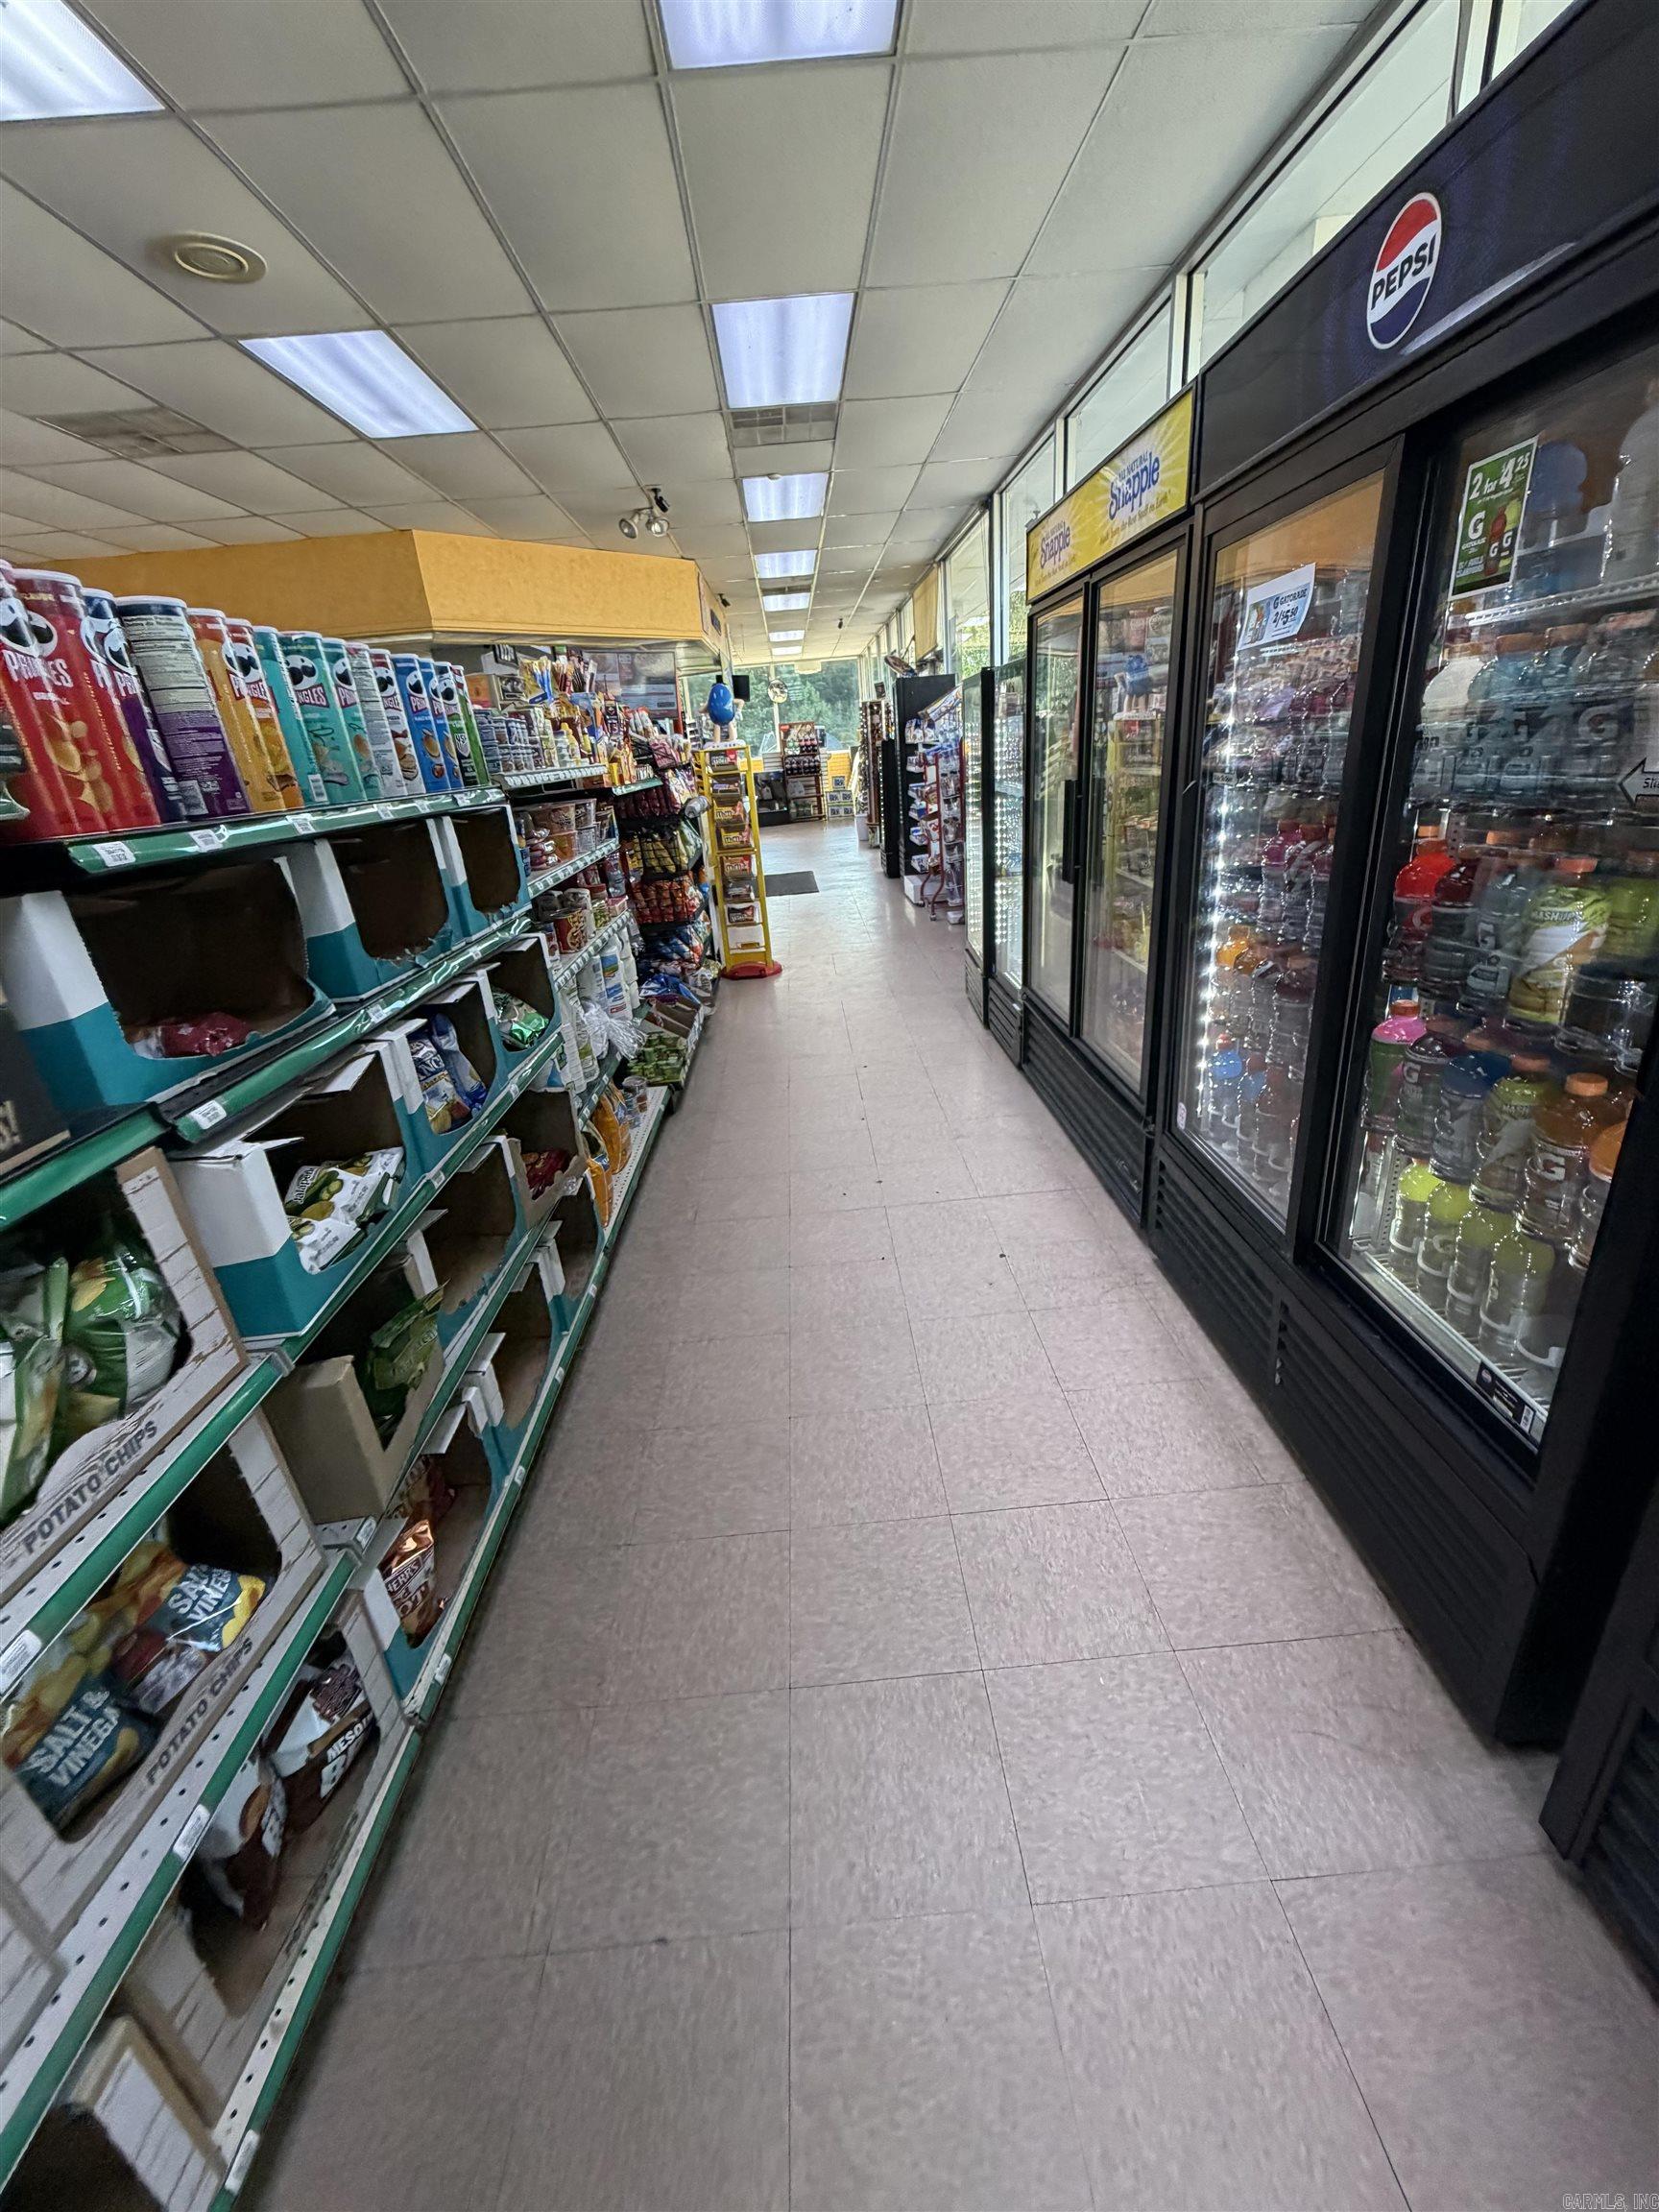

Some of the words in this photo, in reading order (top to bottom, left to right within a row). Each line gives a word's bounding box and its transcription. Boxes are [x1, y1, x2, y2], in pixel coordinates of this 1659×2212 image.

[1370, 232, 1437, 311] PEPSI
[1109, 451, 1160, 521] Snapple
[1469, 471, 1483, 500] 2
[1040, 520, 1070, 569] Snapple
[1468, 510, 1486, 540] G
[1502, 531, 1513, 548] G
[1489, 541, 1499, 558] G
[1280, 588, 1308, 606] GATORADE
[1537, 1152, 1566, 1182] G
[22, 1472, 103, 1555] POTATO
[104, 1419, 158, 1477] CHIPS
[27, 1705, 92, 1774] SALT
[146, 1697, 208, 1786] POTATO
